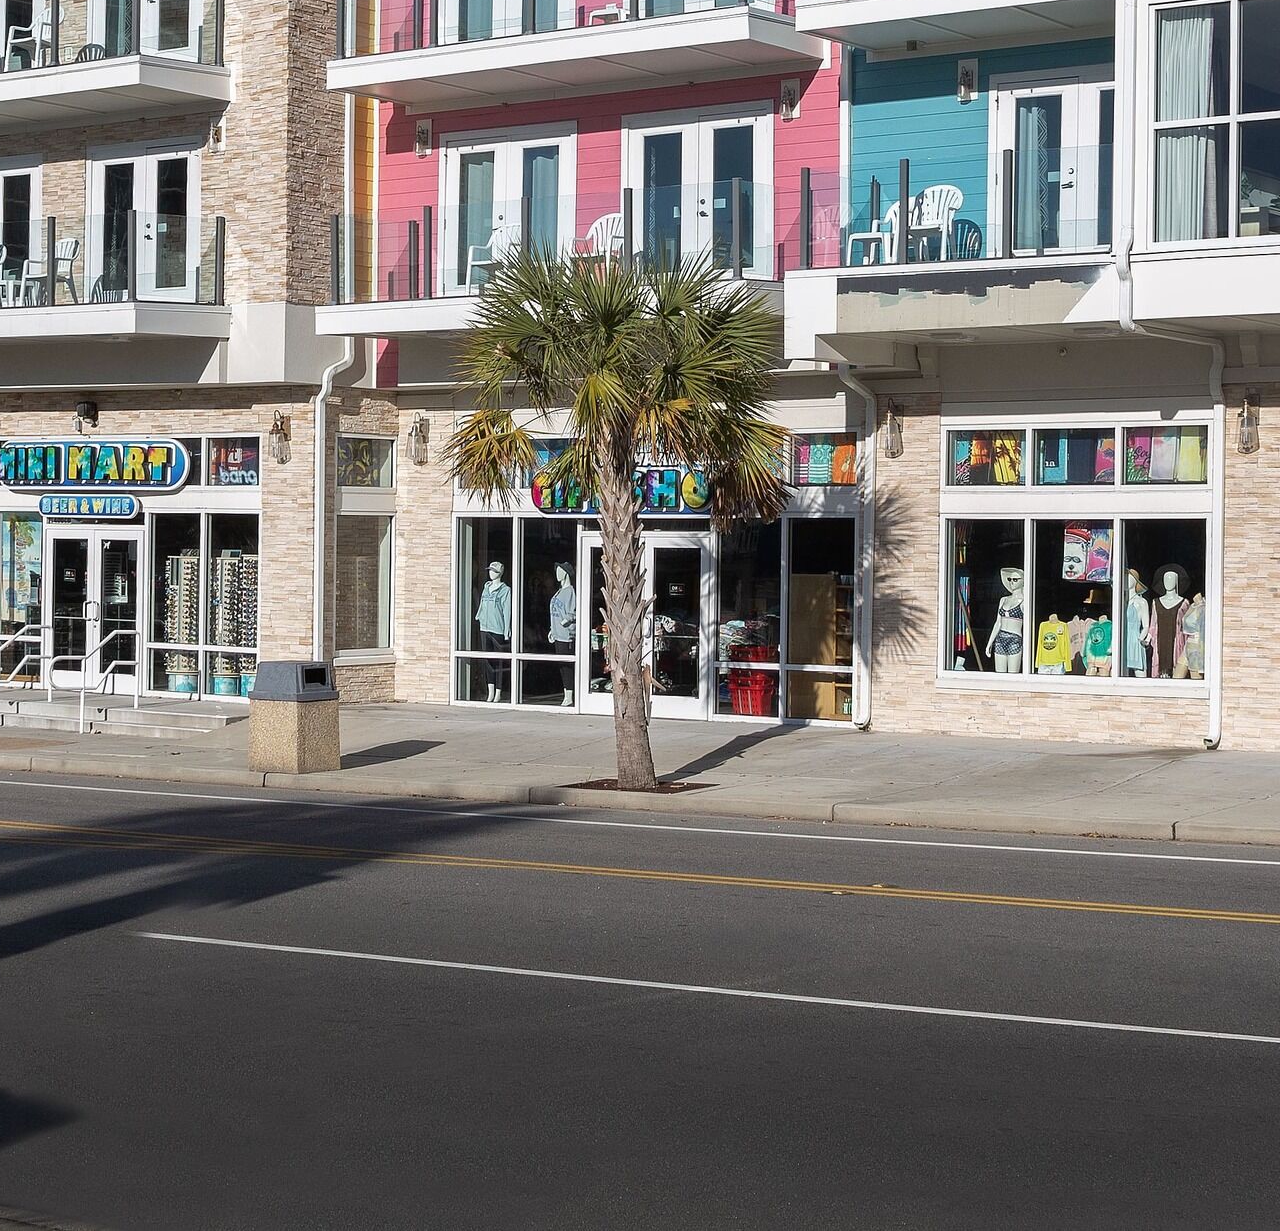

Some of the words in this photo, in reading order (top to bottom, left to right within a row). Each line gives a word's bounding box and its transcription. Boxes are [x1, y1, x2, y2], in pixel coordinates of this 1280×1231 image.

[0, 446, 56, 480] MINI
[68, 445, 168, 481] MART
[41, 497, 78, 514] BEER
[80, 497, 90, 514] &
[91, 497, 131, 514] WINE
